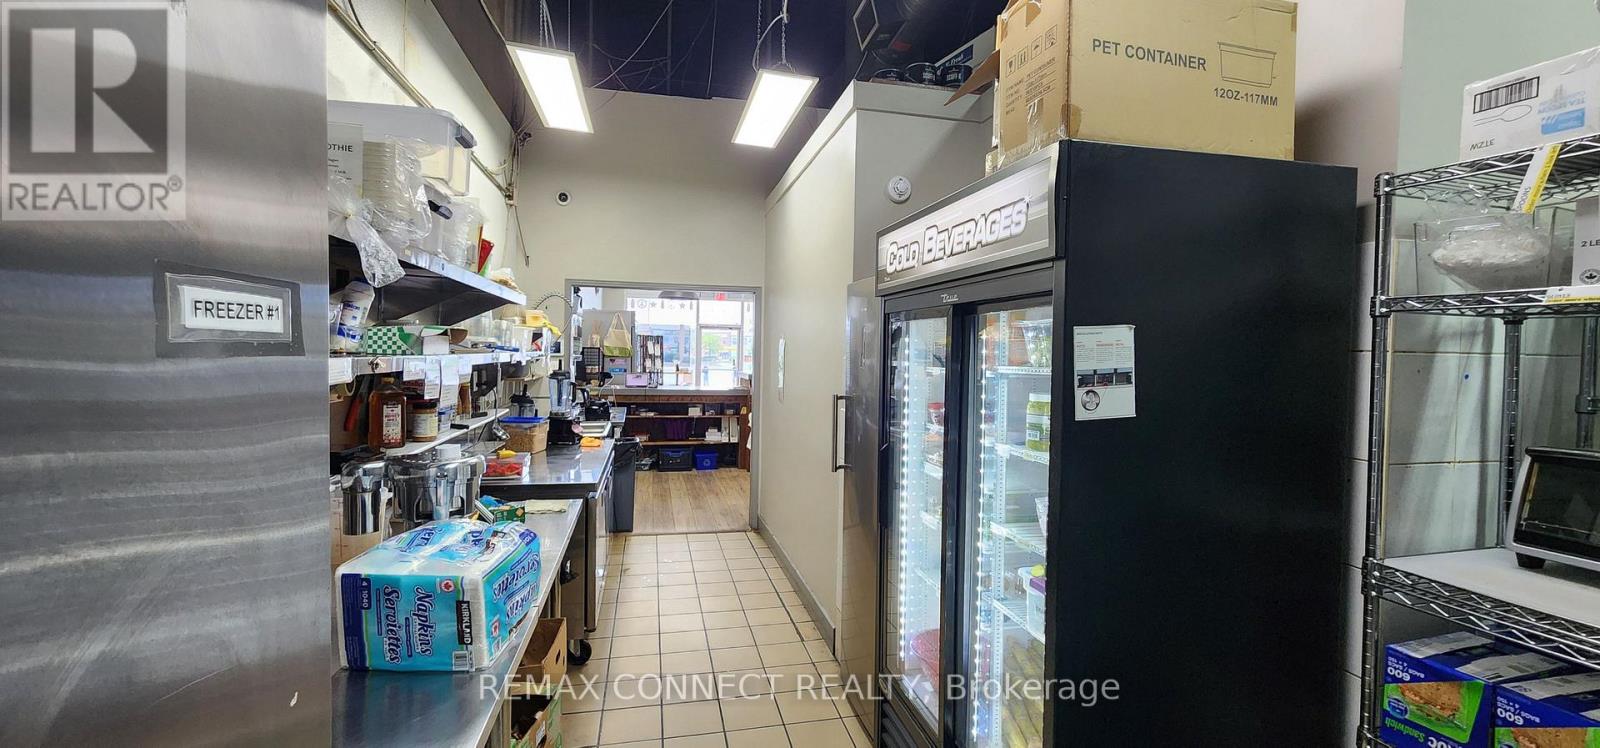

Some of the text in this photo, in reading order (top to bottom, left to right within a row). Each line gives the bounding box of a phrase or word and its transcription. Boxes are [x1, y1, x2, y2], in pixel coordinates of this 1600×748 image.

[1093, 38, 1207, 71] PET CONTAINER
[1214, 88, 1278, 107] 12OZ-117MM
[887, 198, 1029, 274] COLD BEVERAGES
[194, 301, 281, 325] FREEZER #1
[361, 590, 369, 608] 1040
[505, 583, 538, 622] apkins
[383, 585, 402, 664] Serviettes
[410, 586, 436, 656] Napkins
[461, 603, 471, 644] KIRKLAND
[1387, 667, 1410, 681] 600
[1385, 717, 1425, 742] Sandwich
[1497, 708, 1524, 725] 600
